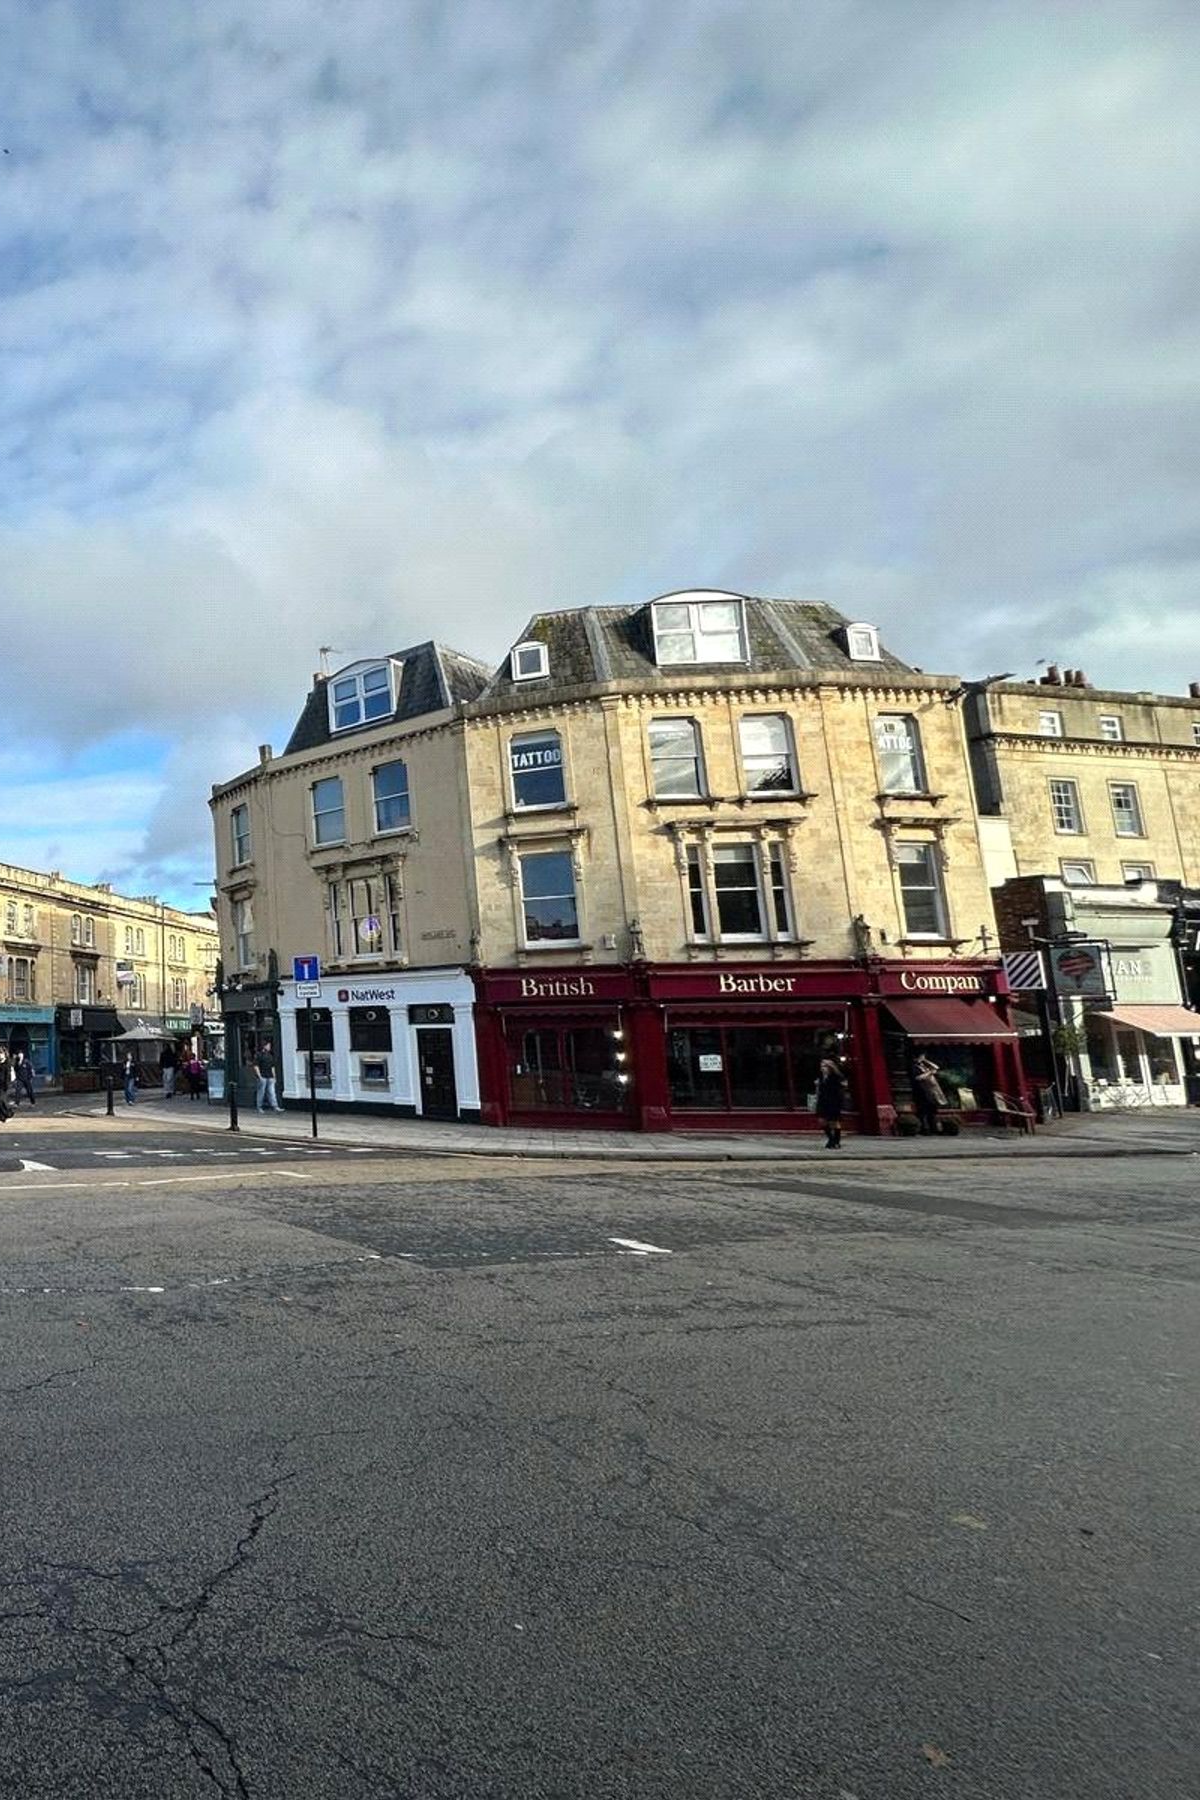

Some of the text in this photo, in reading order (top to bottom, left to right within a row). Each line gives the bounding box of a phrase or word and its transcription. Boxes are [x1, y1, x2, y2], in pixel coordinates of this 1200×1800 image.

[511, 749, 561, 768] TATTOO
[521, 977, 595, 997] British
[719, 973, 797, 993] Barber
[351, 989, 395, 1001] NatWest
